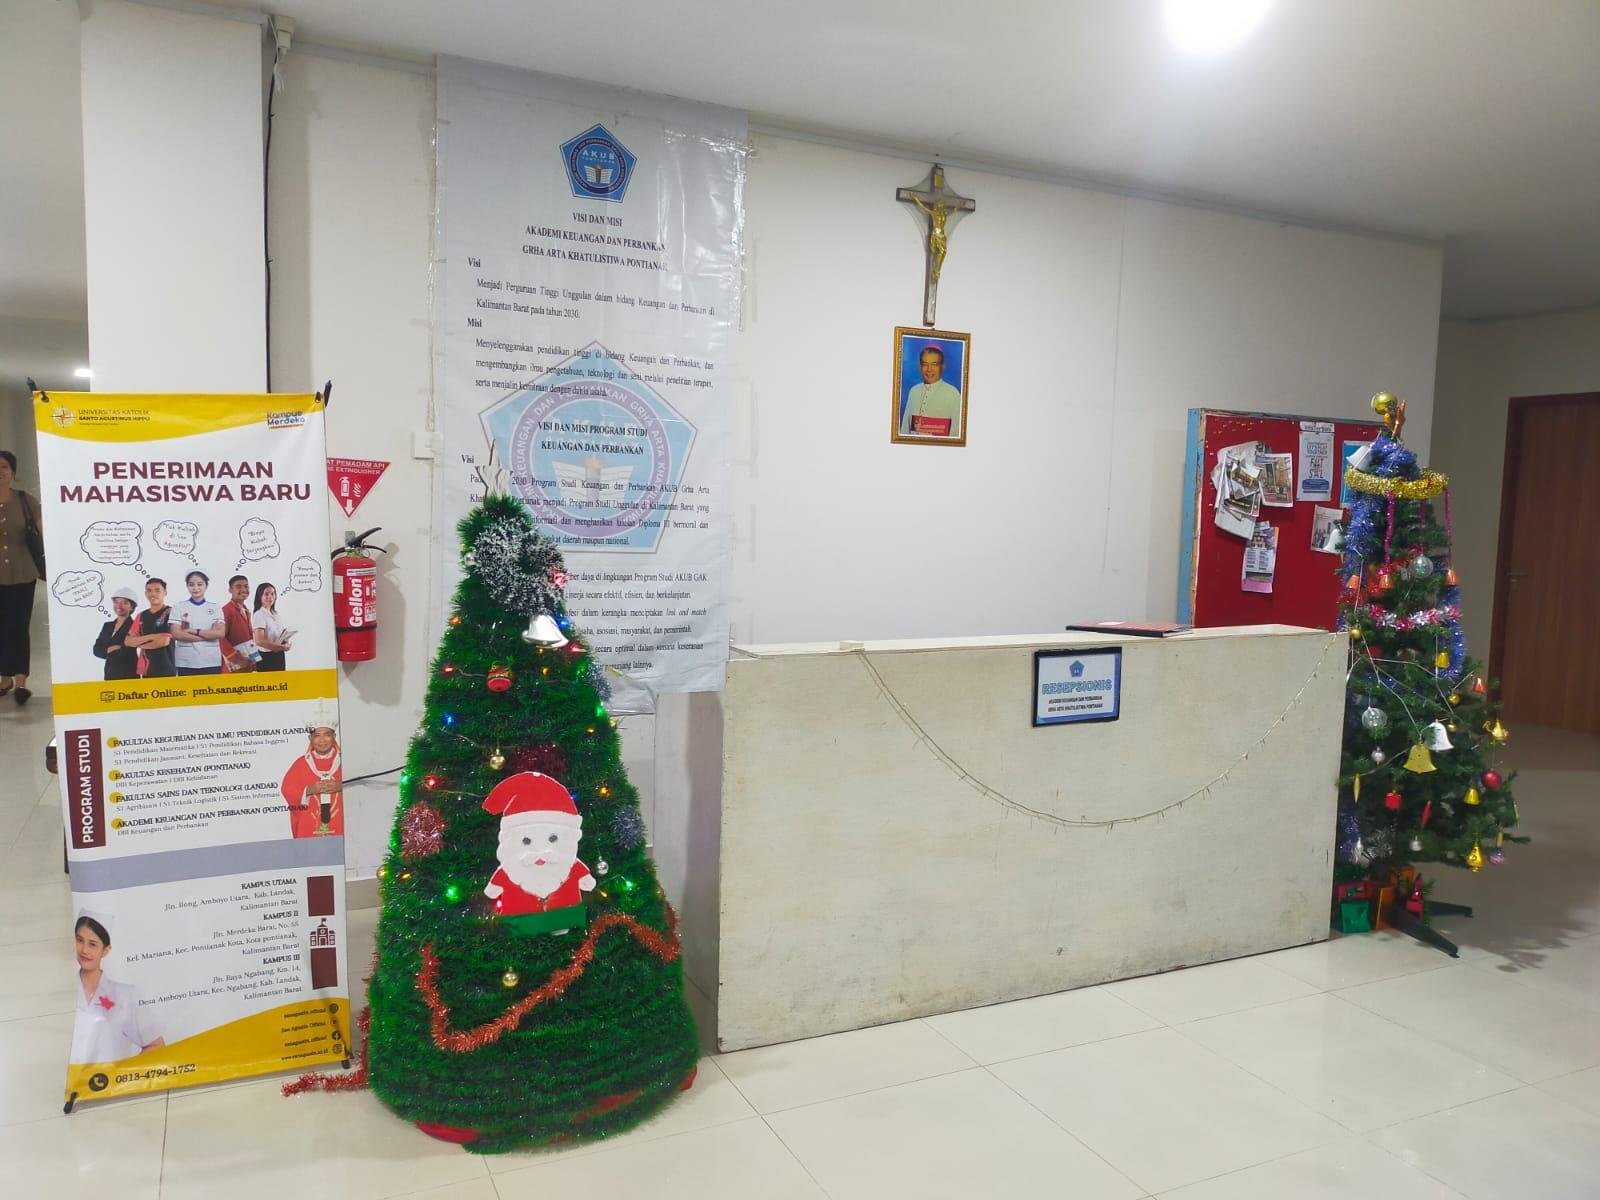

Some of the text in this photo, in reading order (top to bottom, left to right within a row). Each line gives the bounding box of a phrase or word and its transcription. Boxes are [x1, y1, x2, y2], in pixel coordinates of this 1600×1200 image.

[573, 212, 622, 227] VISI DAN MISI
[525, 225, 561, 239] AKADEMI
[563, 231, 605, 243] KEUANGAN
[607, 236, 621, 246] DAN
[468, 257, 480, 267] Visi
[523, 245, 544, 256] GRHA
[546, 248, 566, 259] ARTA
[568, 251, 624, 266] KHATULISTIWA
[477, 279, 665, 309] Menjadi Perguruan Tinggi Unggulan dalam bidang Keuangan
[476, 298, 580, 319] Kalimantan Barat pada tahun 2030.
[468, 318, 482, 328] Misi
[476, 338, 533, 352] Menyelenggarakan
[475, 379, 490, 388] serta
[267, 411, 303, 419] Kampus
[267, 417, 305, 426] Merdeka
[538, 422, 648, 437] VISI DAN MISI PROGRAM STUDI
[541, 441, 644, 455] KEUANGAN DAN PERBANKAN
[336, 460, 372, 468] PEMADAM
[461, 454, 474, 464] Visi
[93, 461, 274, 479] PENERIMAAN
[335, 467, 381, 475] EXTINGUISHER
[532, 478, 556, 488] Program
[561, 479, 576, 488] Studi
[60, 483, 311, 503] MAHASISWA BARU
[675, 573, 693, 581] AKUB
[694, 573, 707, 581] GAK
[349, 578, 363, 627] Gellon
[118, 683, 288, 701] Daftar Online: pmb.sanagustin.ac.id
[1042, 679, 1112, 695] RESEPSIONIS
[113, 736, 153, 747] FAKULTAS
[154, 734, 196, 744] KEGURUAN
[198, 732, 215, 740] DAN
[216, 731, 235, 739] ILMU
[237, 729, 281, 738] PENDIDIKAN
[114, 762, 250, 780] FAKULTAS KESEHATAN (PONTIANAK)
[78, 735, 94, 843] PROGRAM STUDI
[115, 793, 155, 803] FAKULTAS
[182, 788, 198, 796] DAN
[200, 785, 243, 794] TEKNOLOGI
[244, 782, 278, 791] (LANDAK)
[117, 818, 153, 828] AKADEMI
[155, 814, 197, 824] KEUANGAN
[200, 811, 216, 819] DAN
[217, 807, 261, 818] PERBANKAN
[241, 878, 297, 890] KAMPUS UTAMA
[200, 896, 228, 906] Amboyo
[240, 902, 279, 911] Kalimantan
[263, 912, 292, 920] KAMPUS
[227, 927, 256, 936] Merdeka
[142, 951, 174, 961] Mariana,
[191, 942, 226, 952] Pontianak
[246, 936, 261, 945] Kota
[242, 942, 300, 955] Kalimantan Barat
[263, 956, 292, 965] KAMPUS
[138, 998, 156, 1007] Desa
[158, 993, 187, 1003] Amboyo
[244, 986, 302, 1000] Kalimantan Barat
[115, 1064, 196, 1083] 0813-4794-1752
